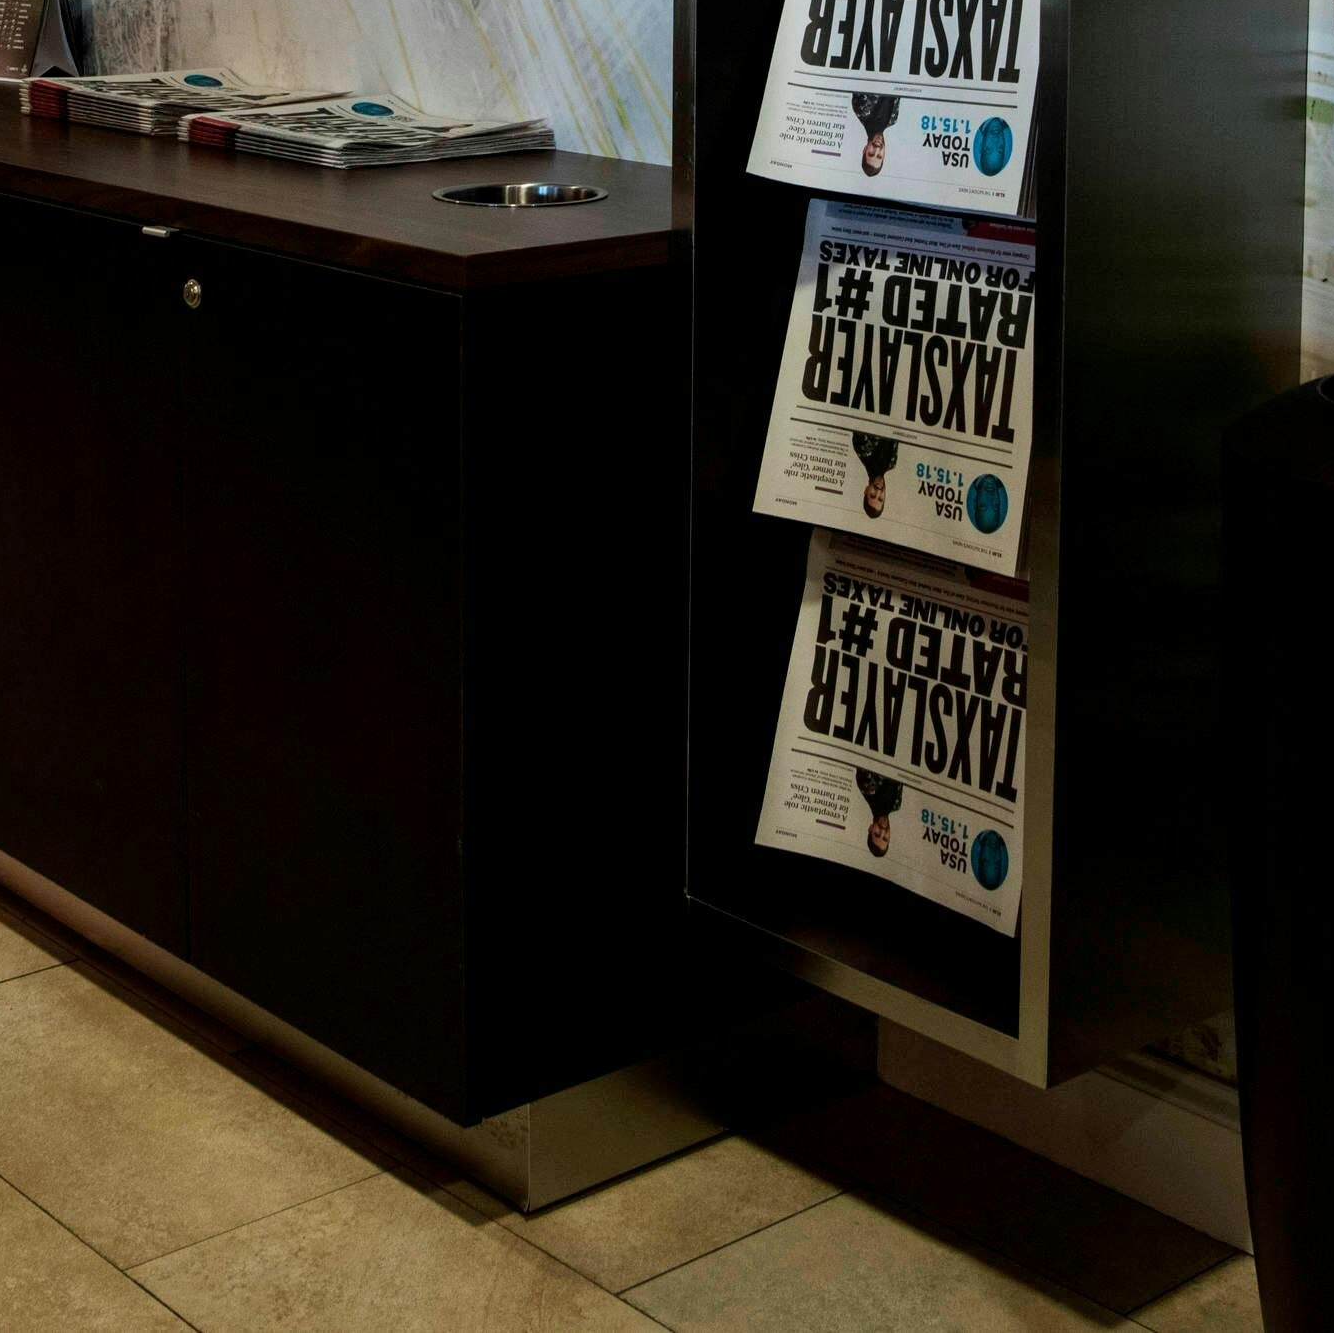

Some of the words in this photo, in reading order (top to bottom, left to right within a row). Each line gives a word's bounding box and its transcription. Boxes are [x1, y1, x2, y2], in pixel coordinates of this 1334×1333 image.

[785, 115, 805, 125] Criss
[806, 119, 831, 129] Darren
[832, 122, 845, 130] star
[920, 115, 970, 134] 1.15.18
[778, 132, 794, 140] role
[795, 135, 836, 147] creeptastic
[808, 128, 833, 139] former
[837, 141, 842, 149] A
[922, 132, 970, 151] TODAY
[941, 150, 969, 168] USA
[819, 240, 889, 270] TAXES
[894, 251, 981, 284] ONLINE
[985, 264, 1036, 293] FOR
[813, 262, 873, 319] #1
[882, 275, 1031, 347] RATED
[803, 316, 1015, 440] TAXSLAYER
[789, 451, 808, 461] Criss
[809, 455, 833, 466] Darren
[833, 459, 847, 468] star
[783, 468, 798, 477] role
[799, 469, 838, 484] creeptastic
[811, 465, 835, 477] former
[916, 462, 963, 487] 1.15.18
[838, 479, 844, 487] A
[917, 480, 963, 505] TODAY
[774, 497, 797, 505] MONDAY
[934, 500, 962, 521] USA
[822, 570, 896, 611] TAXES
[898, 593, 986, 637] ONLINE
[816, 594, 878, 656] #1
[886, 617, 1028, 707] RATED
[805, 647, 1020, 799] TAXSLAYER
[790, 782, 809, 794] Criss
[810, 787, 835, 801] Darren
[783, 800, 799, 809] role
[812, 797, 837, 811] former
[836, 794, 850, 803] star
[800, 804, 841, 819] creeptastic
[841, 813, 847, 822] A
[920, 808, 968, 839] 1.15.18
[922, 825, 968, 857] TODAY
[939, 848, 967, 874] USA
